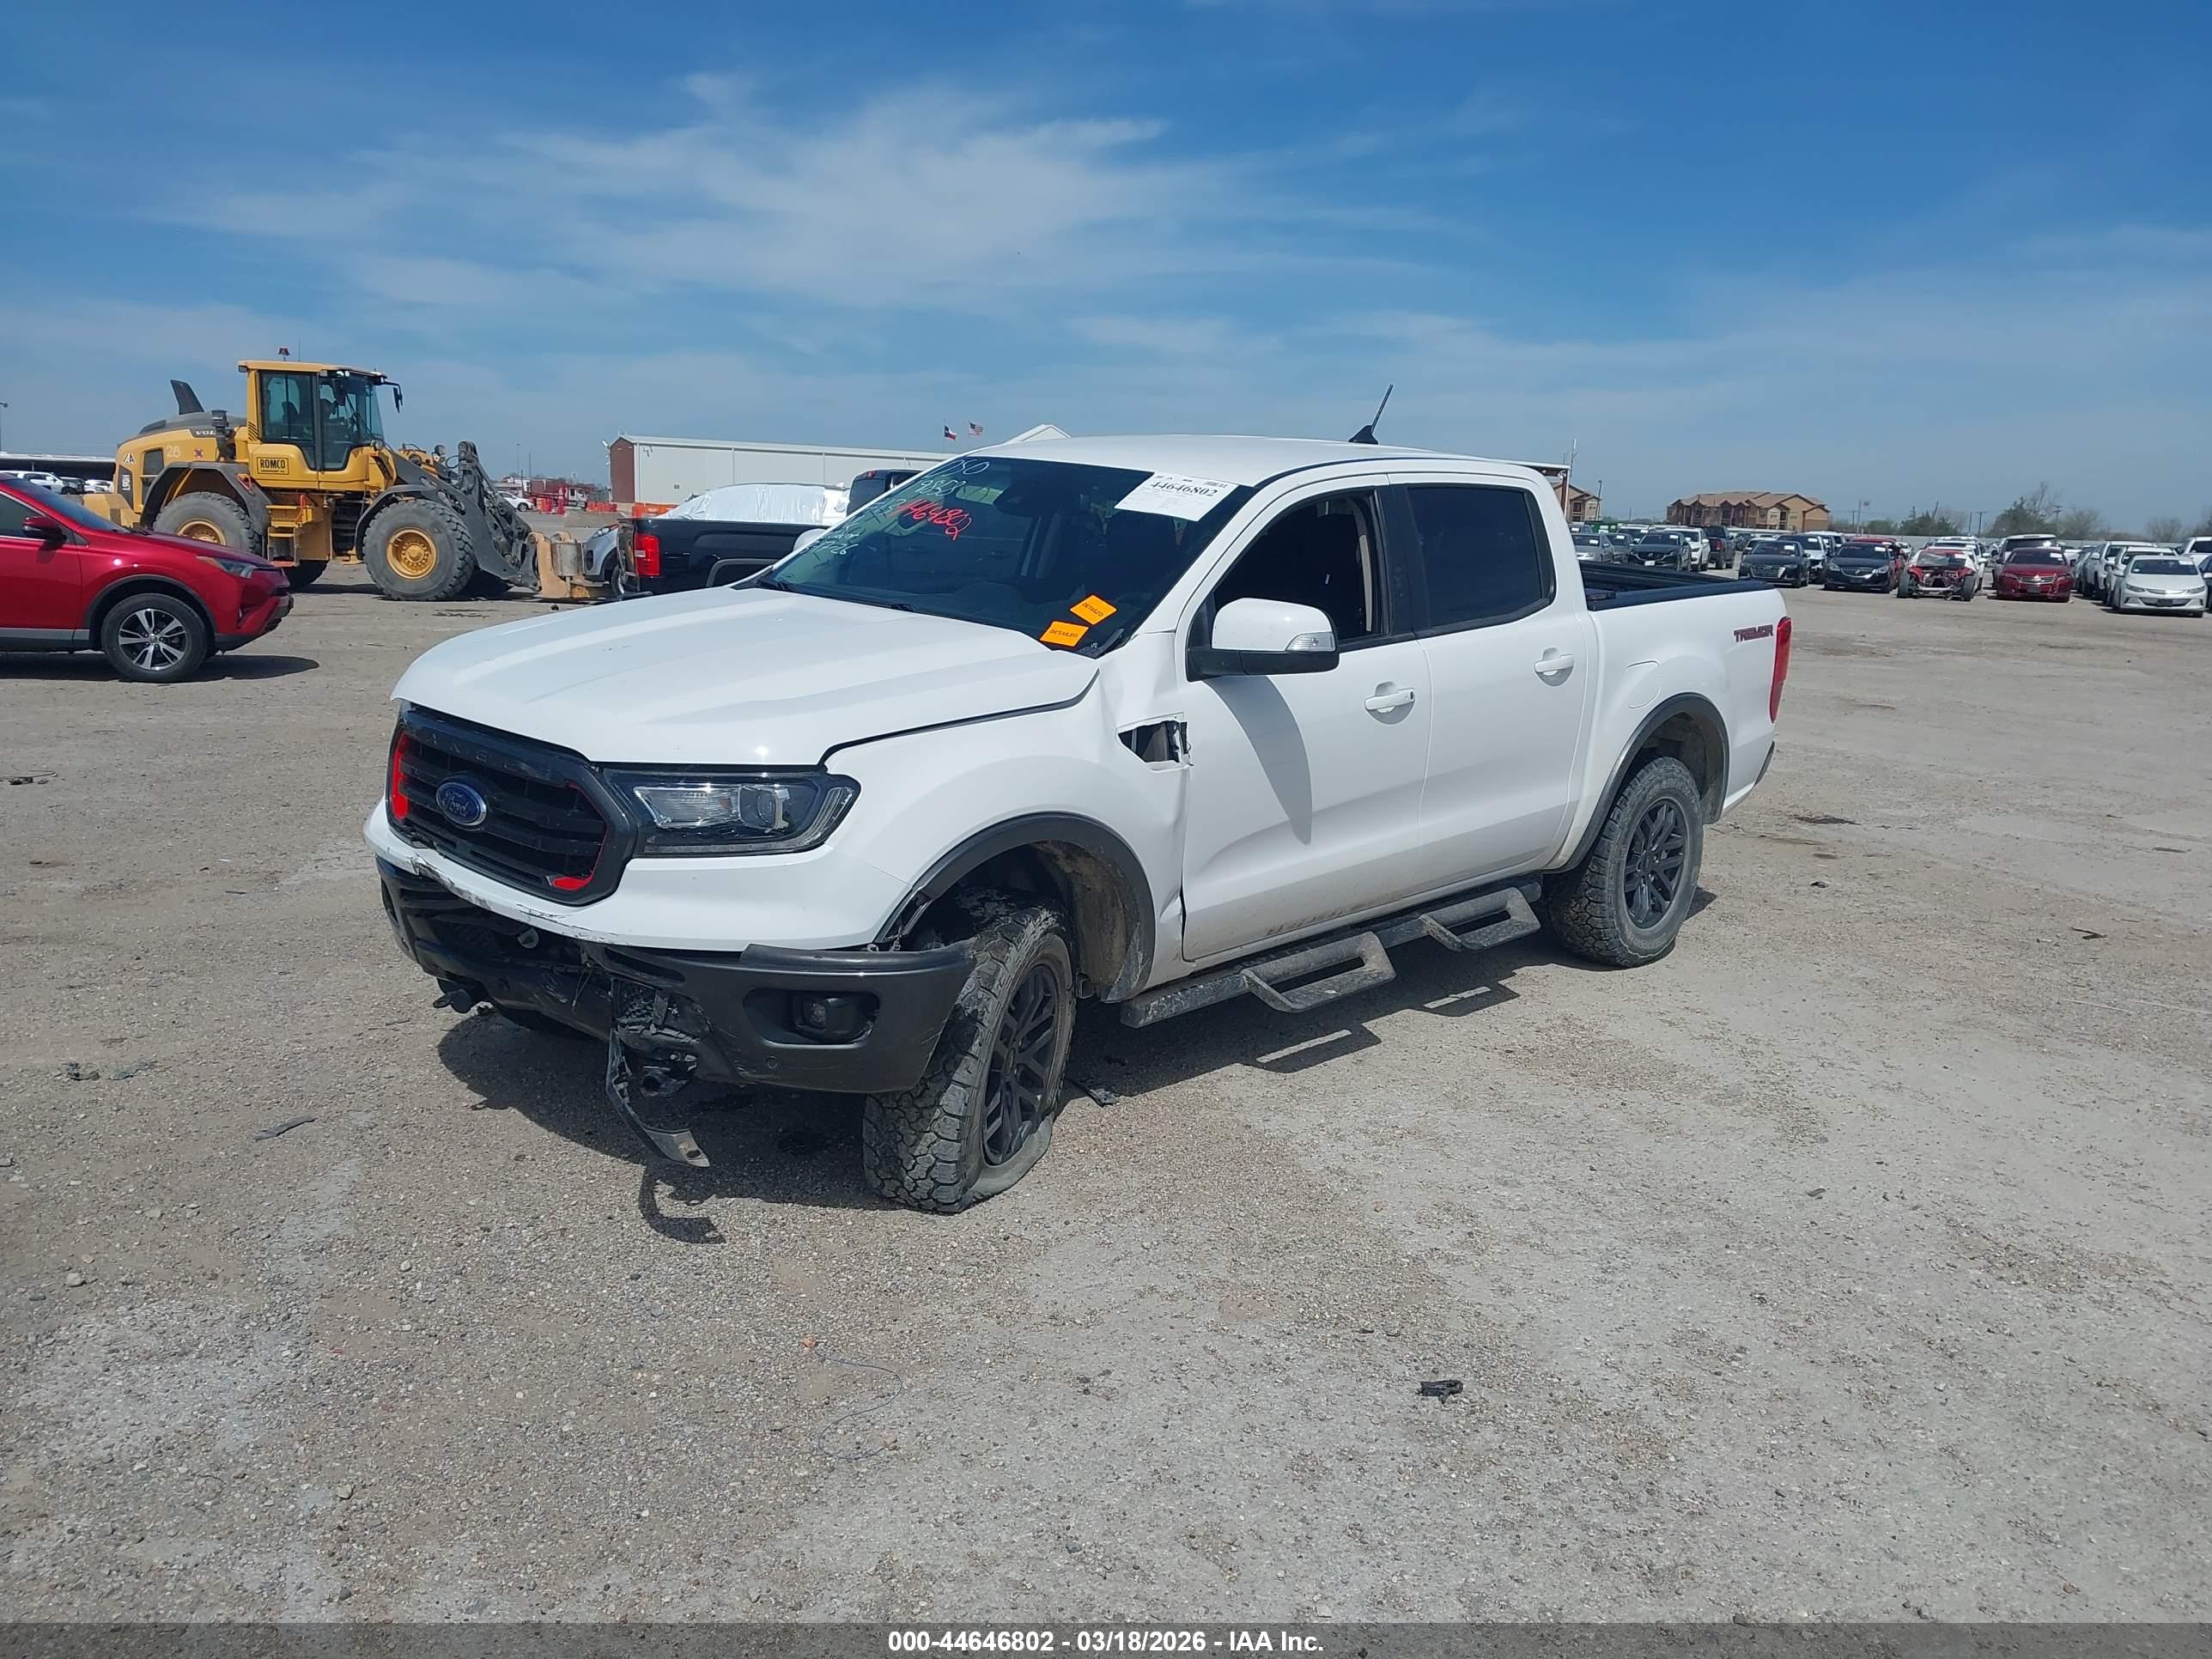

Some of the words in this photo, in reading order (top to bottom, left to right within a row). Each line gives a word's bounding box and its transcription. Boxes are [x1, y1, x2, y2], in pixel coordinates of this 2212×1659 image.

[166, 446, 180, 458] 28
[259, 459, 285, 469] ROMCO
[1150, 481, 1218, 497] 44646802
[441, 789, 470, 817] Ford
